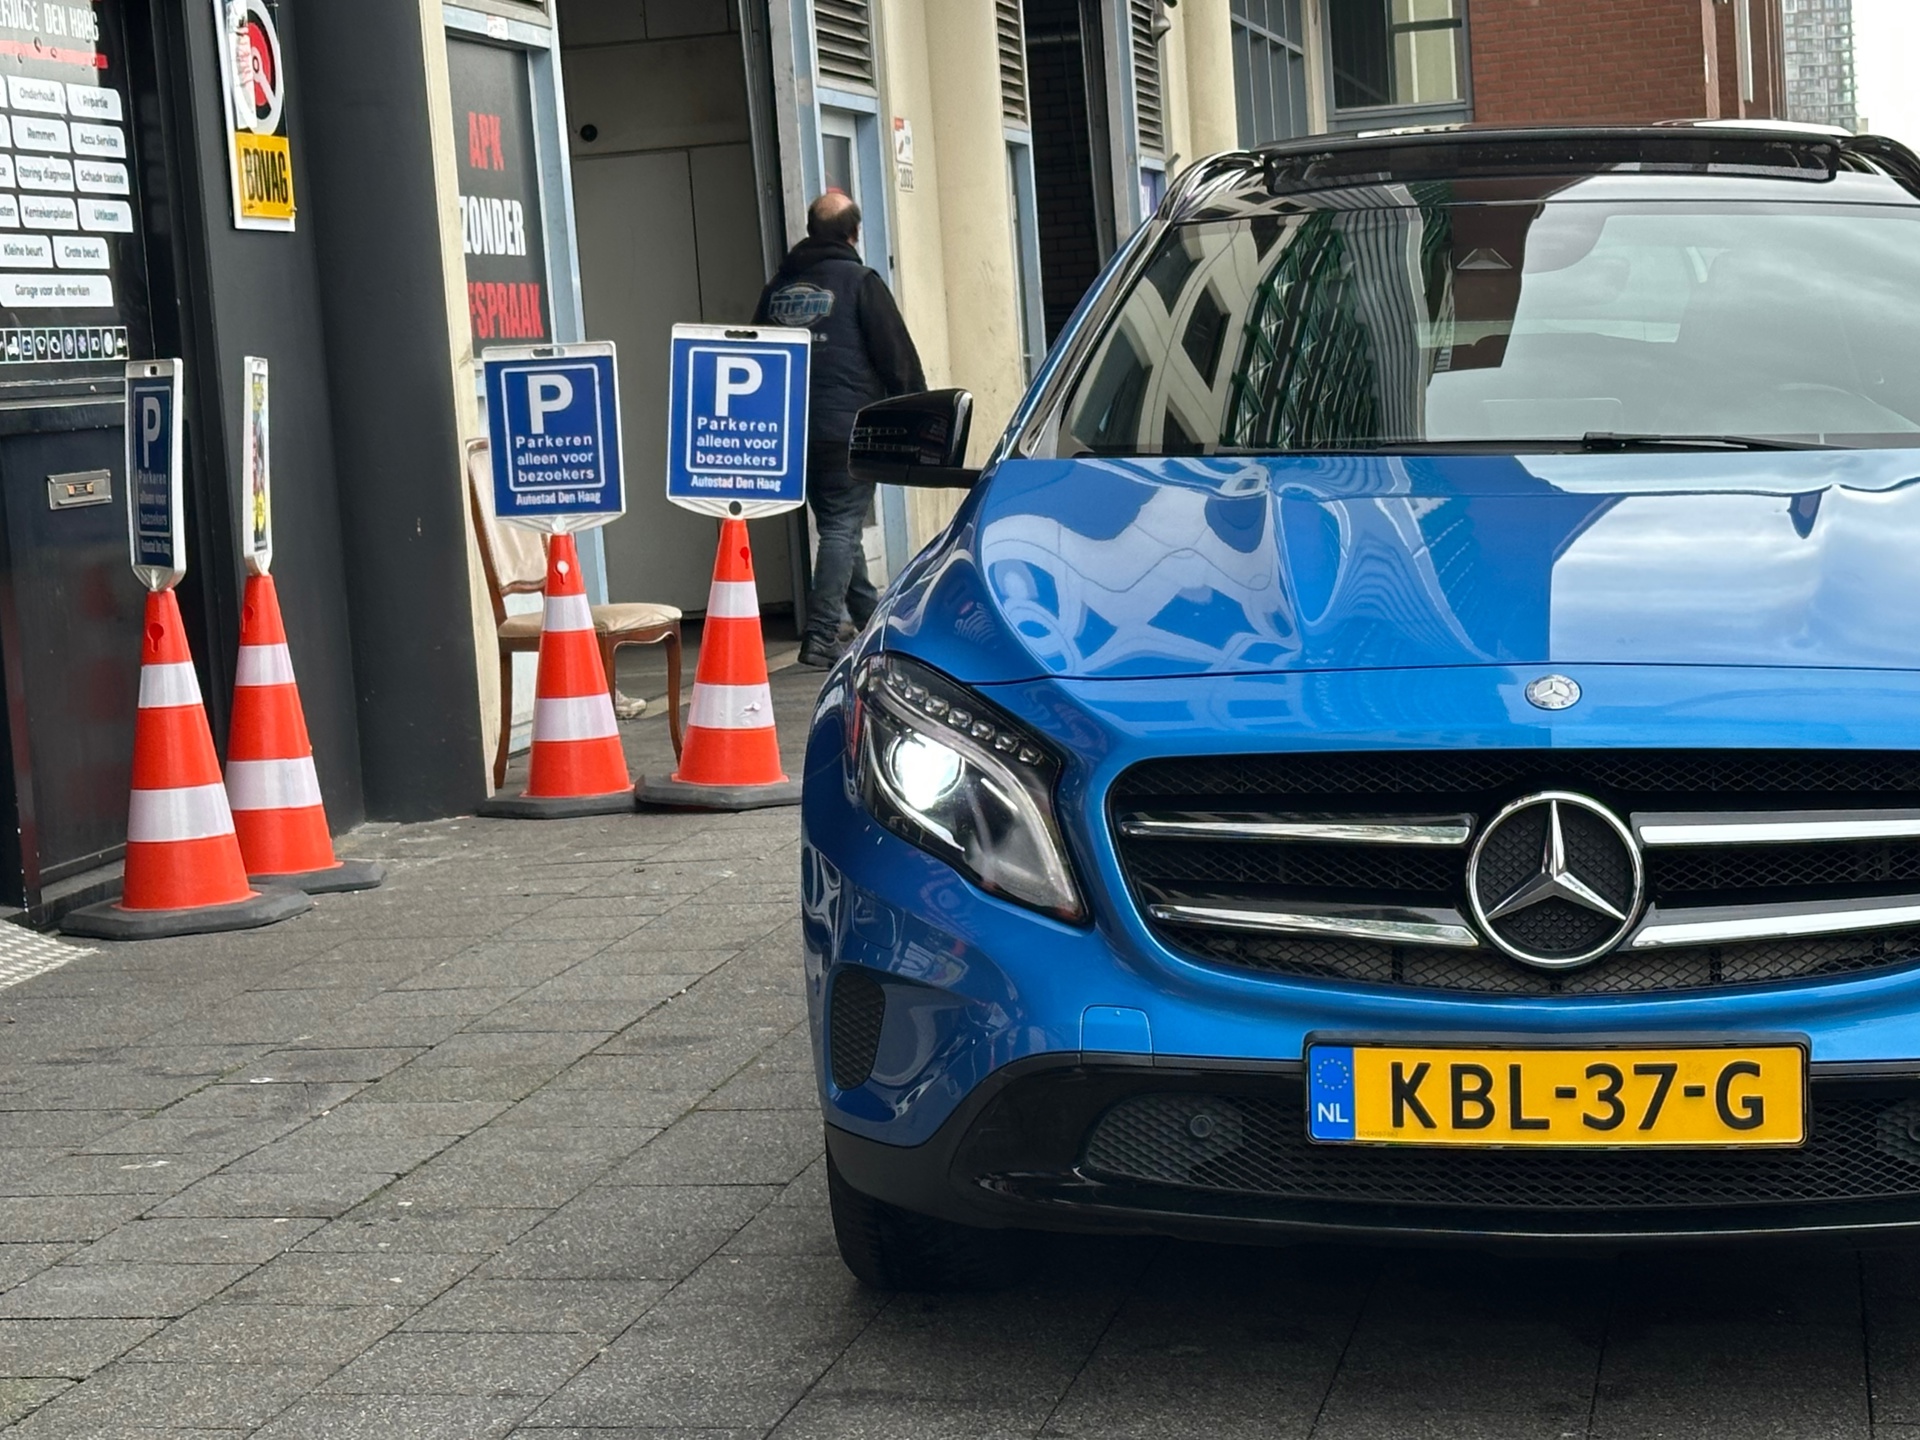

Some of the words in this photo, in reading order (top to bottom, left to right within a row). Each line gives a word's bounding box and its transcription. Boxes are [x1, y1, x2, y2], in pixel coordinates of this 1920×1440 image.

[0, 0, 40, 32] RVICE
[43, 3, 67, 36] DEN
[69, 6, 99, 40] HAAG
[96, 135, 118, 148] Service
[468, 111, 504, 171] APK
[243, 148, 289, 204] BOVAG
[459, 196, 526, 256] ZONDER
[4, 243, 24, 256] Kleine
[25, 245, 43, 257] beurt
[64, 246, 82, 258] Grote
[82, 247, 100, 259] beurt
[15, 284, 38, 299] Garage
[40, 286, 53, 296] voor
[54, 284, 65, 296] alle
[66, 285, 90, 296] merken
[468, 282, 544, 338] FSPRAAK
[715, 356, 763, 417] P
[527, 374, 573, 434] P
[143, 396, 161, 468] P
[697, 416, 778, 433] Parkeren
[515, 435, 593, 449] Parkeren
[696, 435, 740, 448] alleen
[744, 437, 778, 450] voor
[517, 452, 557, 466] alleen
[562, 452, 593, 463] voor
[696, 451, 777, 467] bezoekers
[518, 468, 595, 483] bezoekers
[691, 474, 734, 489] Autostad
[736, 477, 754, 490] Den
[756, 477, 781, 493] Haag
[516, 491, 556, 506] Autostad
[558, 491, 576, 504] Den
[577, 490, 601, 505] Haag
[1390, 1061, 1765, 1131] KBL-37-G
[1317, 1102, 1349, 1124] NL
